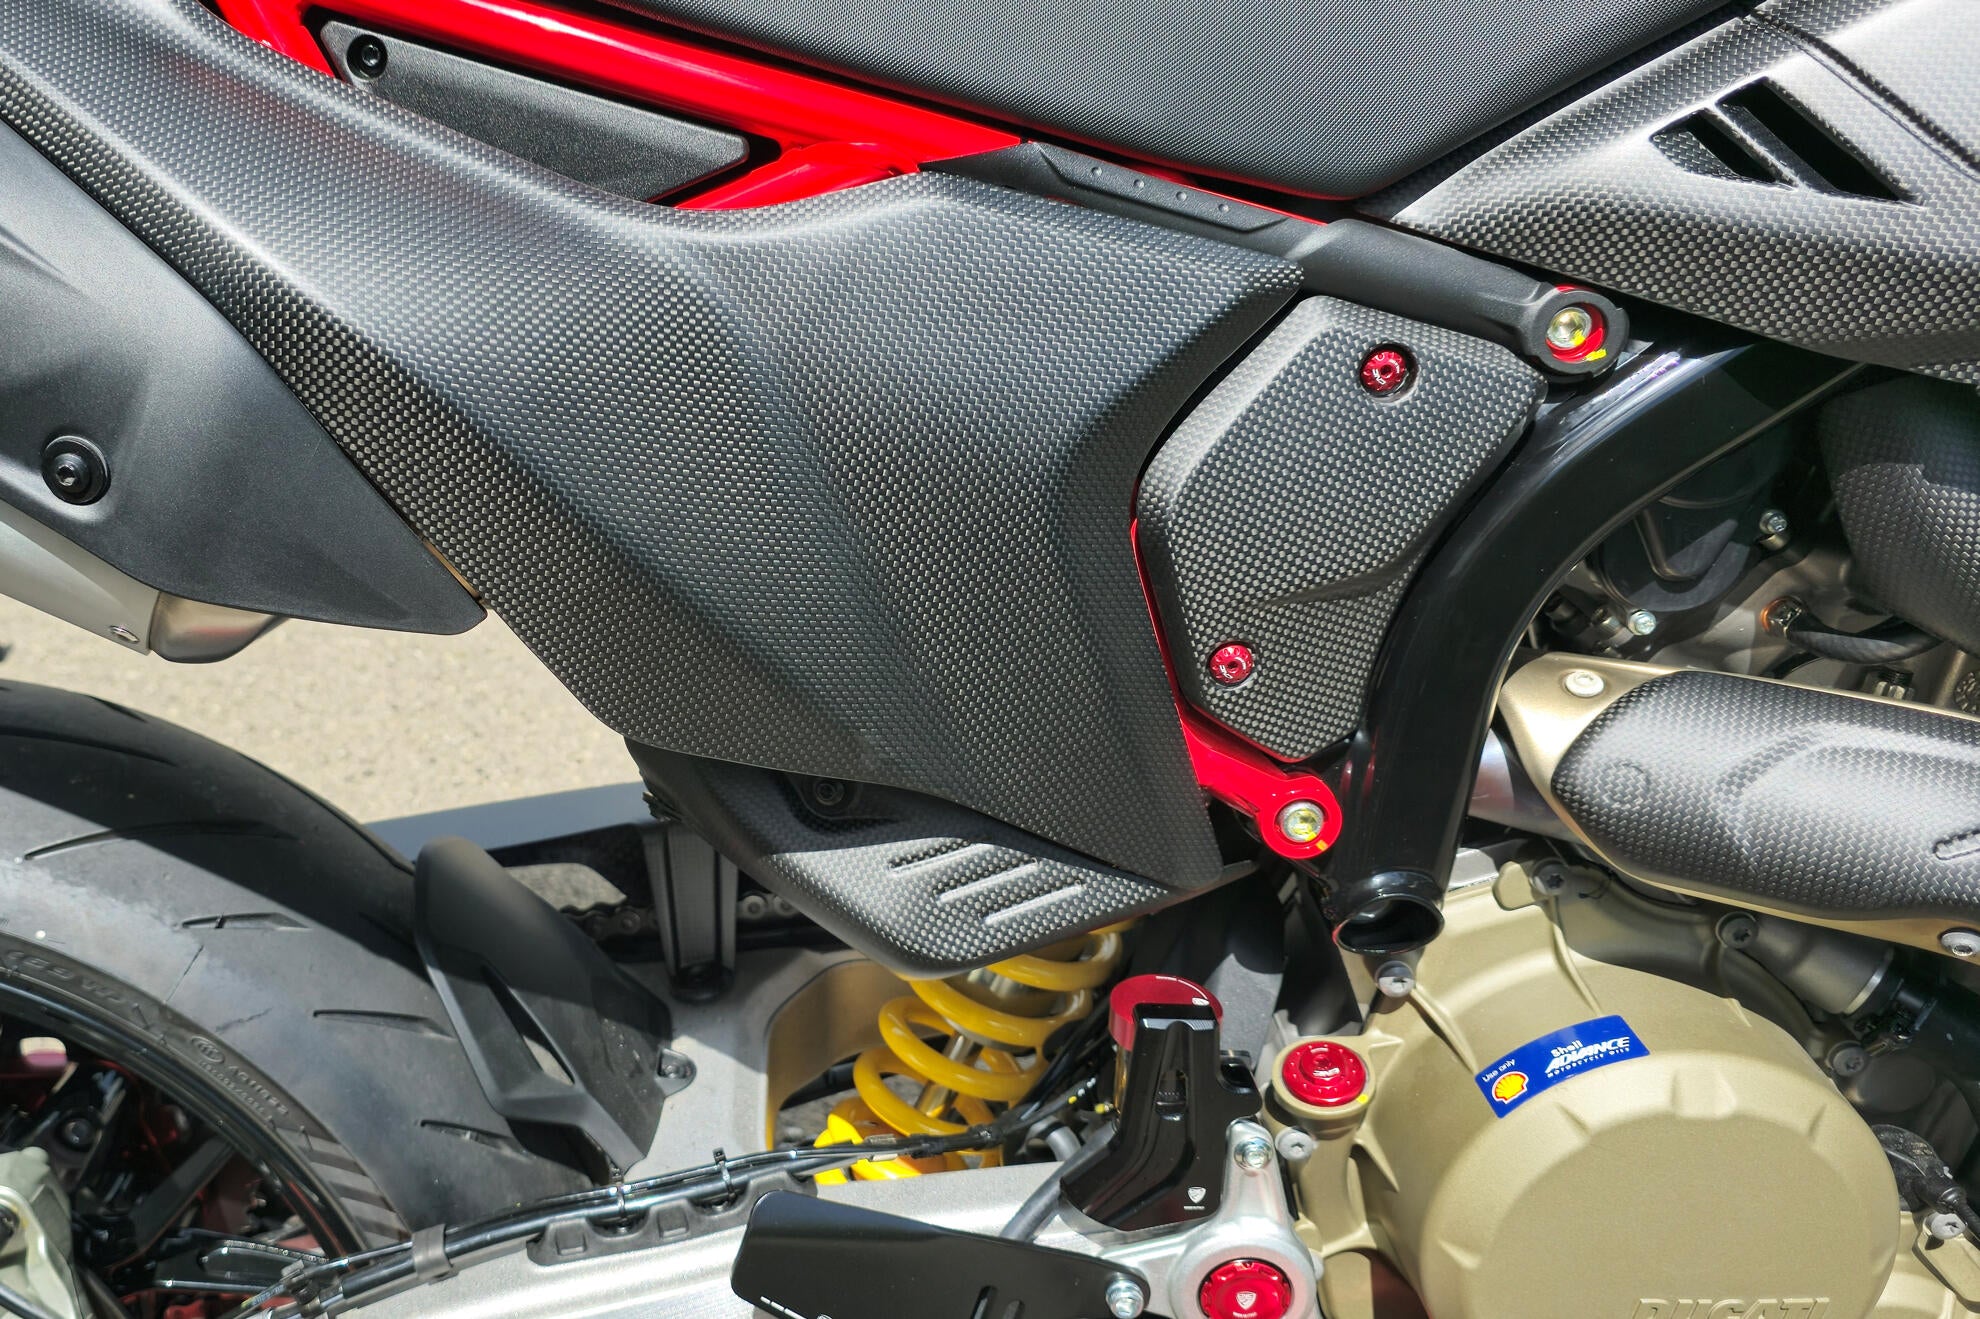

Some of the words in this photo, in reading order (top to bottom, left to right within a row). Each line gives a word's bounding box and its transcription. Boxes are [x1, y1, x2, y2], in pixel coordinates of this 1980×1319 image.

[1544, 1036, 1630, 1074] ADVANCE
[1550, 1040, 1584, 1058] Shell
[1482, 1069, 1499, 1083] Use
[1499, 1058, 1516, 1072] only
